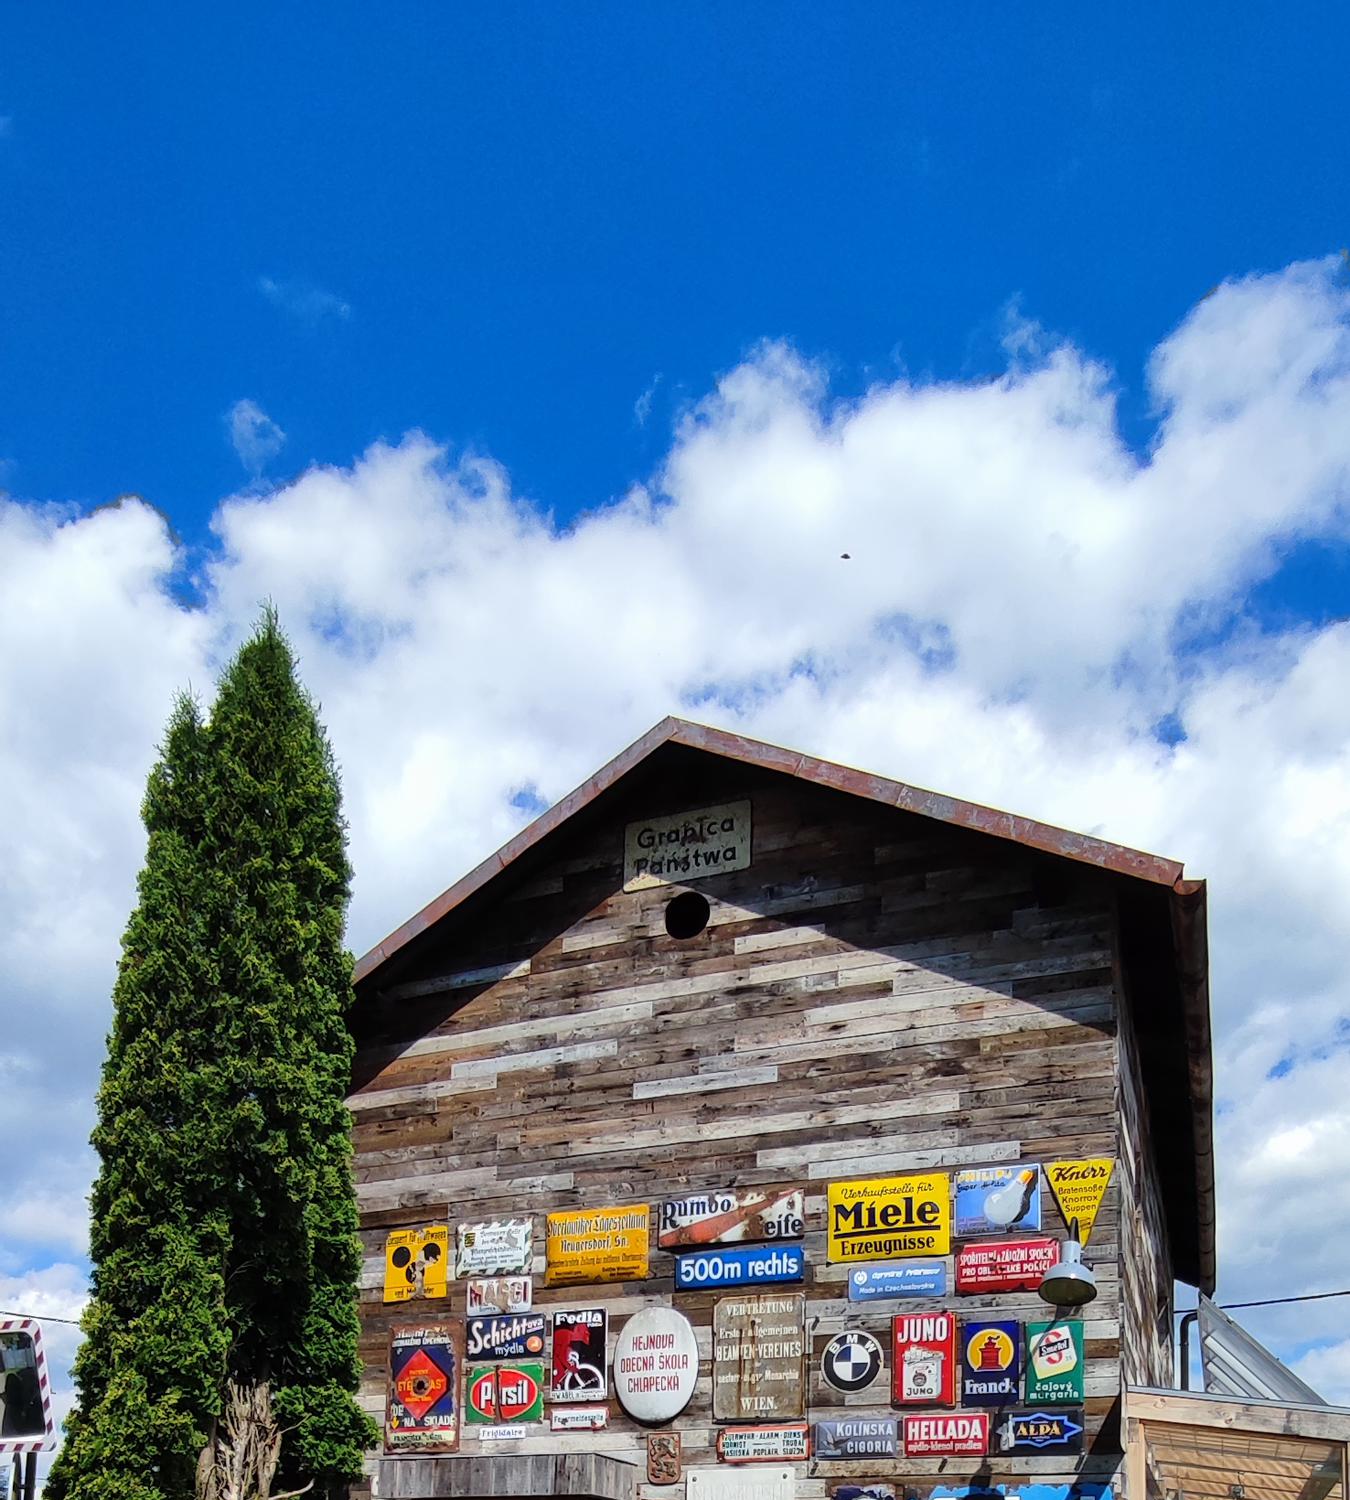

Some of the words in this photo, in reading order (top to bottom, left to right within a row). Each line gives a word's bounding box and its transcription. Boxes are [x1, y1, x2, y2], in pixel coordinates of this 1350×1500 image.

[1053, 1165, 1108, 1182] Knorr
[841, 1183, 915, 1199] Verkaufsstelle
[917, 1182, 934, 1194] für
[1062, 1195, 1098, 1204] Knorrox
[661, 1195, 732, 1230] Rumbo
[833, 1197, 940, 1232] Miele
[1065, 1204, 1097, 1213] Suppen
[757, 1213, 803, 1235] eife
[841, 1235, 935, 1256] Erzeugnisse
[680, 1257, 742, 1282] 500m
[748, 1252, 798, 1277] rechts
[962, 1267, 976, 1276] PRO
[859, 1286, 876, 1294] Made
[726, 1301, 793, 1316] VERTRETUNG
[897, 1317, 948, 1343] JUNO
[494, 1342, 525, 1357] mýdla
[632, 1334, 675, 1351] HEJNOVA
[829, 1334, 877, 1354] BMW
[658, 1352, 689, 1370] ŠKOLA
[627, 1372, 680, 1393] CHLAPECKÁ
[964, 1378, 1018, 1395] Franck
[1035, 1381, 1073, 1394] čajový
[480, 1380, 528, 1409] Prsil
[906, 1387, 934, 1397] JUNO
[908, 1419, 983, 1441] HELLADA
[1016, 1421, 1061, 1437] ALPA
